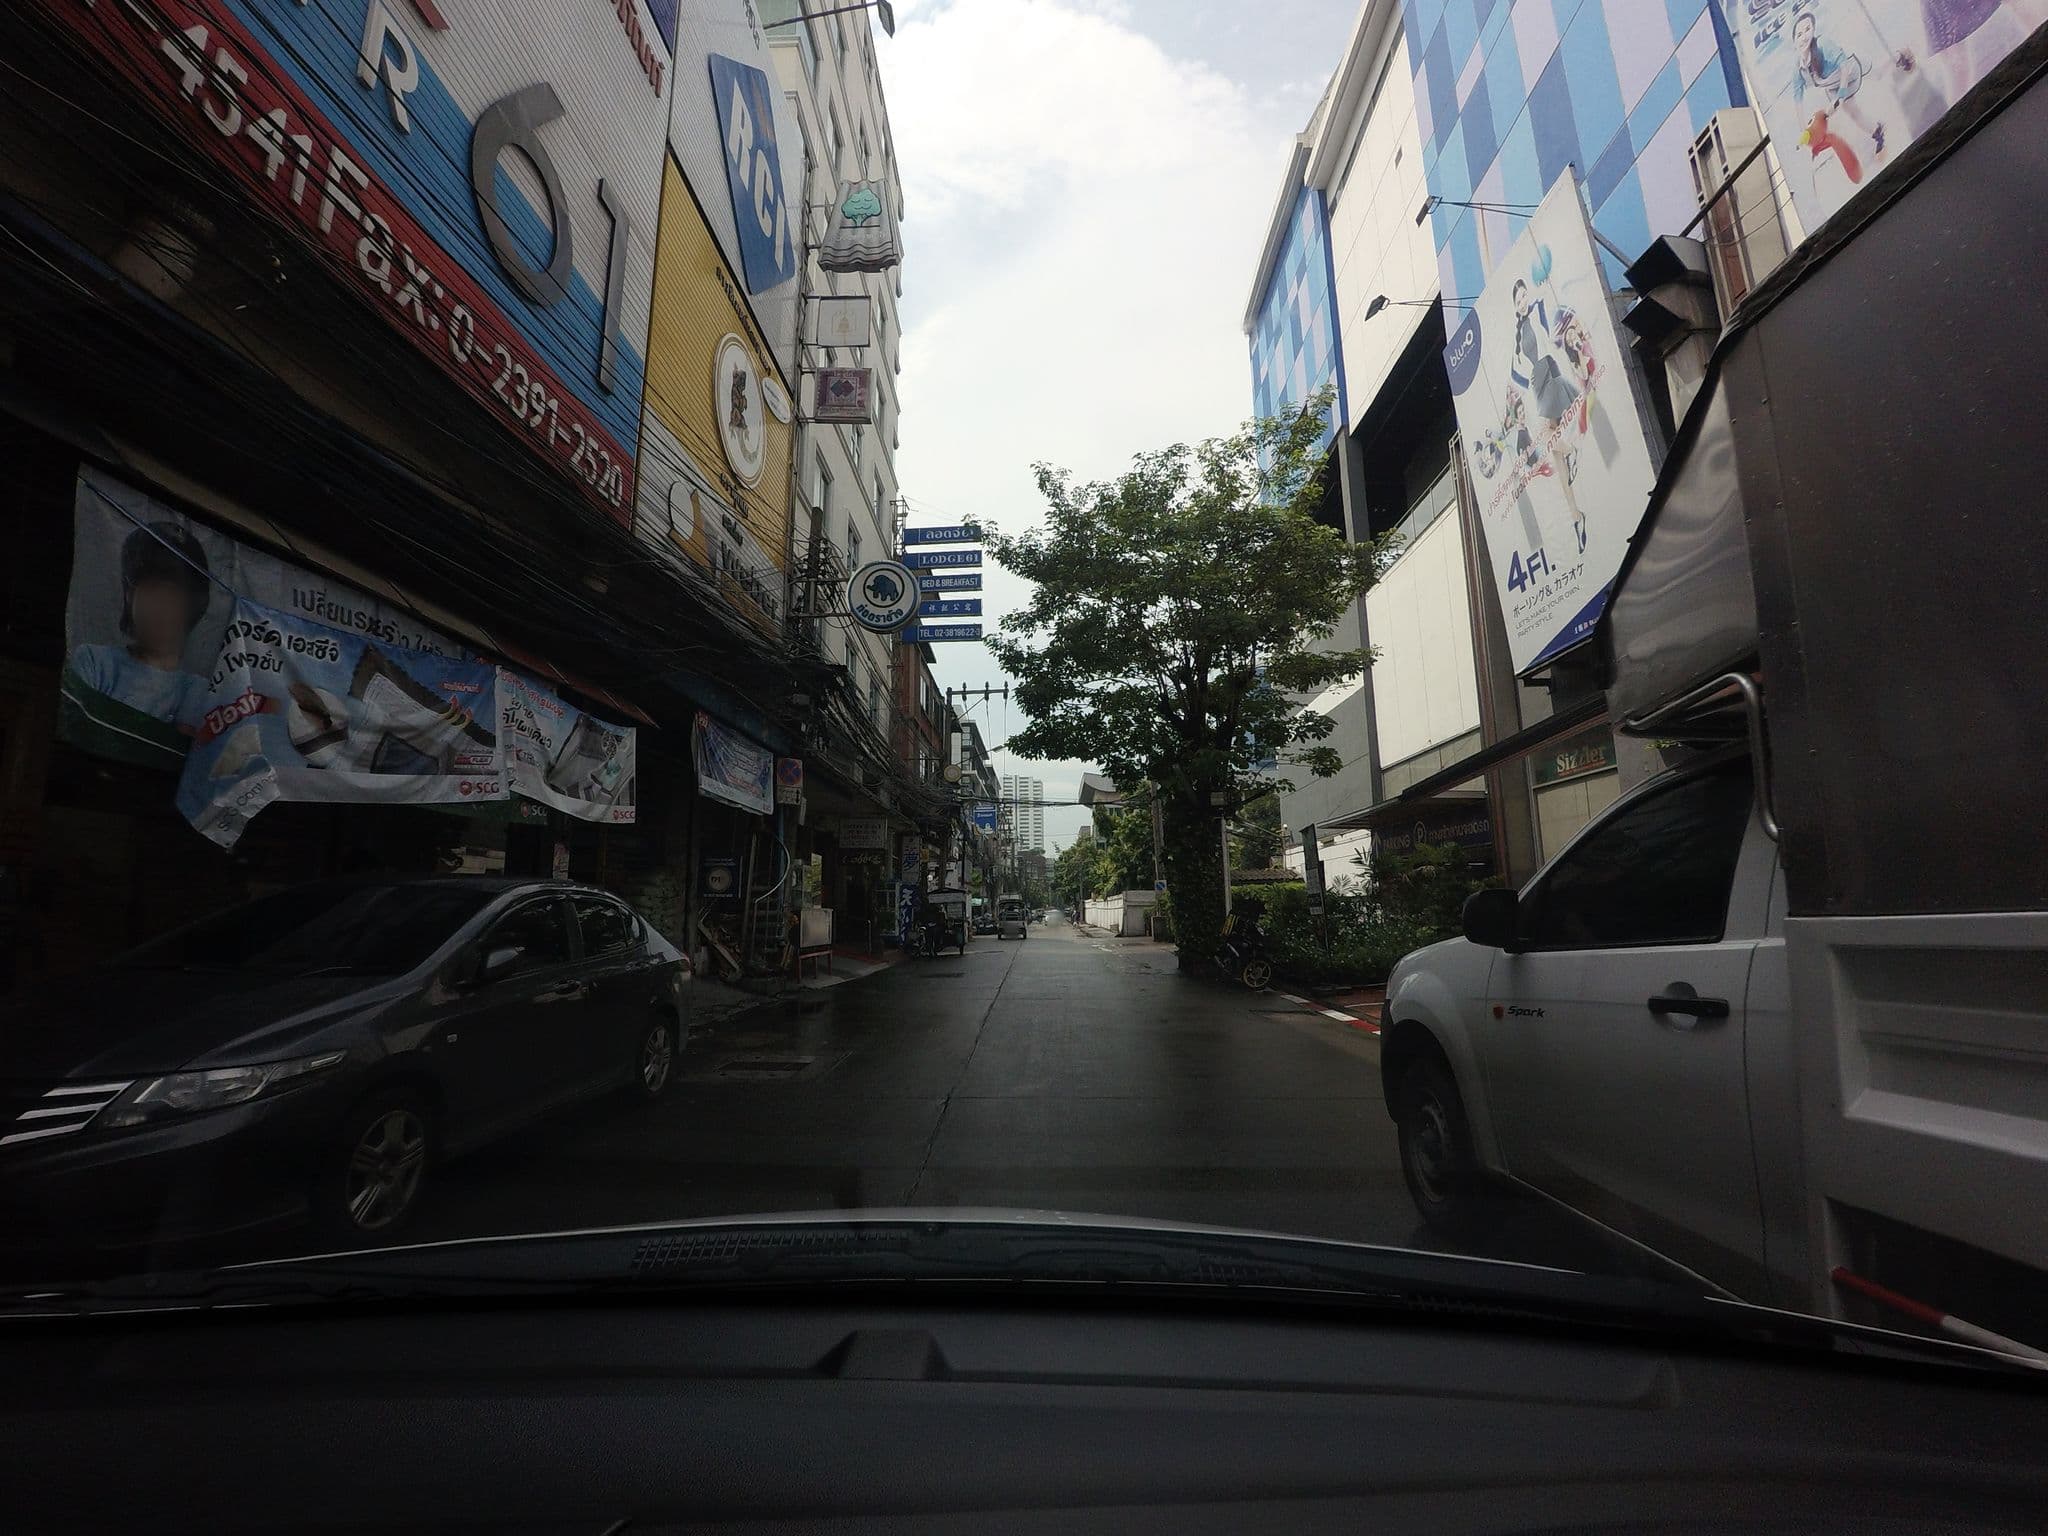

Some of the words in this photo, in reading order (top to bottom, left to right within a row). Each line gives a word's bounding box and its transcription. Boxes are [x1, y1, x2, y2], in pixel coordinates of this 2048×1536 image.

[921, 579, 935, 588] BED
[935, 579, 941, 587] &
[941, 577, 978, 587] BREAKFAST
[1554, 563, 1585, 591] カラオケ
[476, 782, 499, 794] SCG
[1508, 1005, 1545, 1018] Spark
